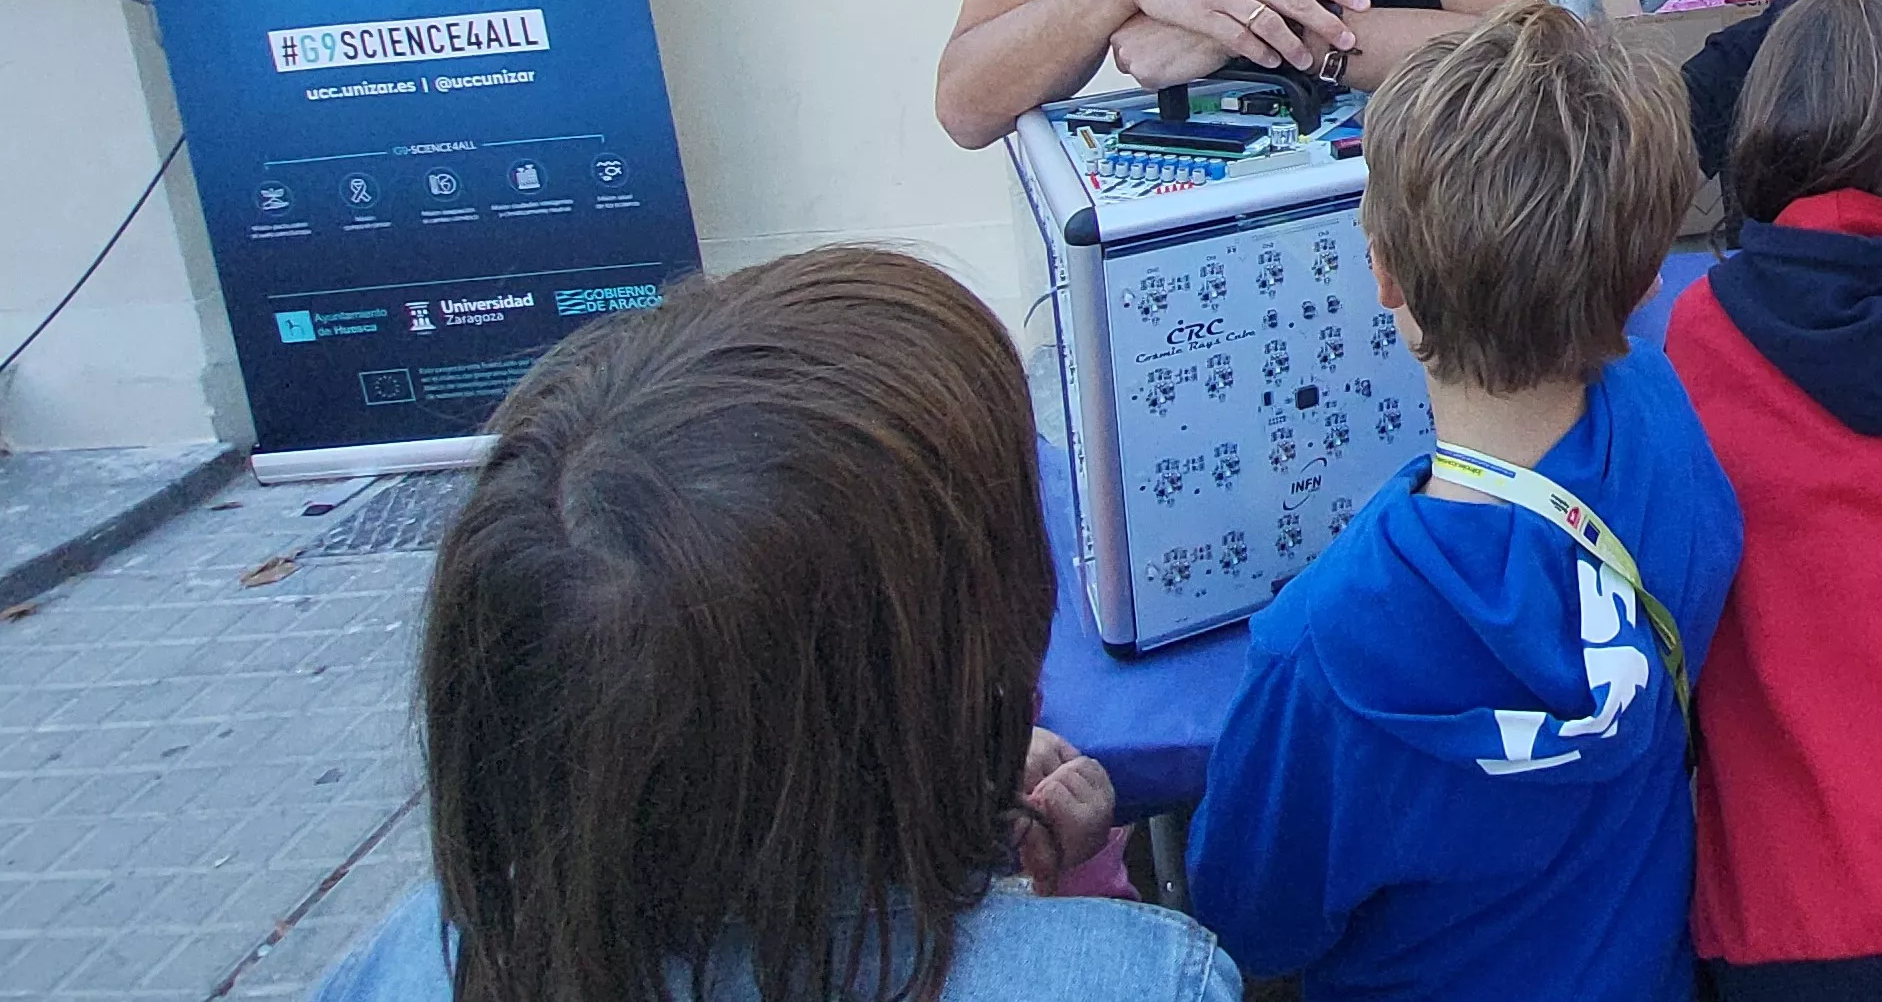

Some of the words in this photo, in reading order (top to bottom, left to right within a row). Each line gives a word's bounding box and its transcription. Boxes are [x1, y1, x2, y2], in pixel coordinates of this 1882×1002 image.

[282, 16, 539, 66] #G9SCIENCE4ALL
[306, 80, 417, 100] ucc.unizar.es
[434, 69, 535, 93] @uccunizar
[441, 292, 534, 314] Universidad
[583, 284, 657, 300] GOBIERNO
[586, 301, 606, 312] DE
[445, 313, 504, 326] Zaragoza
[1167, 318, 1224, 345] CRC
[1135, 347, 1183, 363] Cosmic
[1188, 338, 1221, 351] Rays
[1291, 475, 1321, 495] INFN
